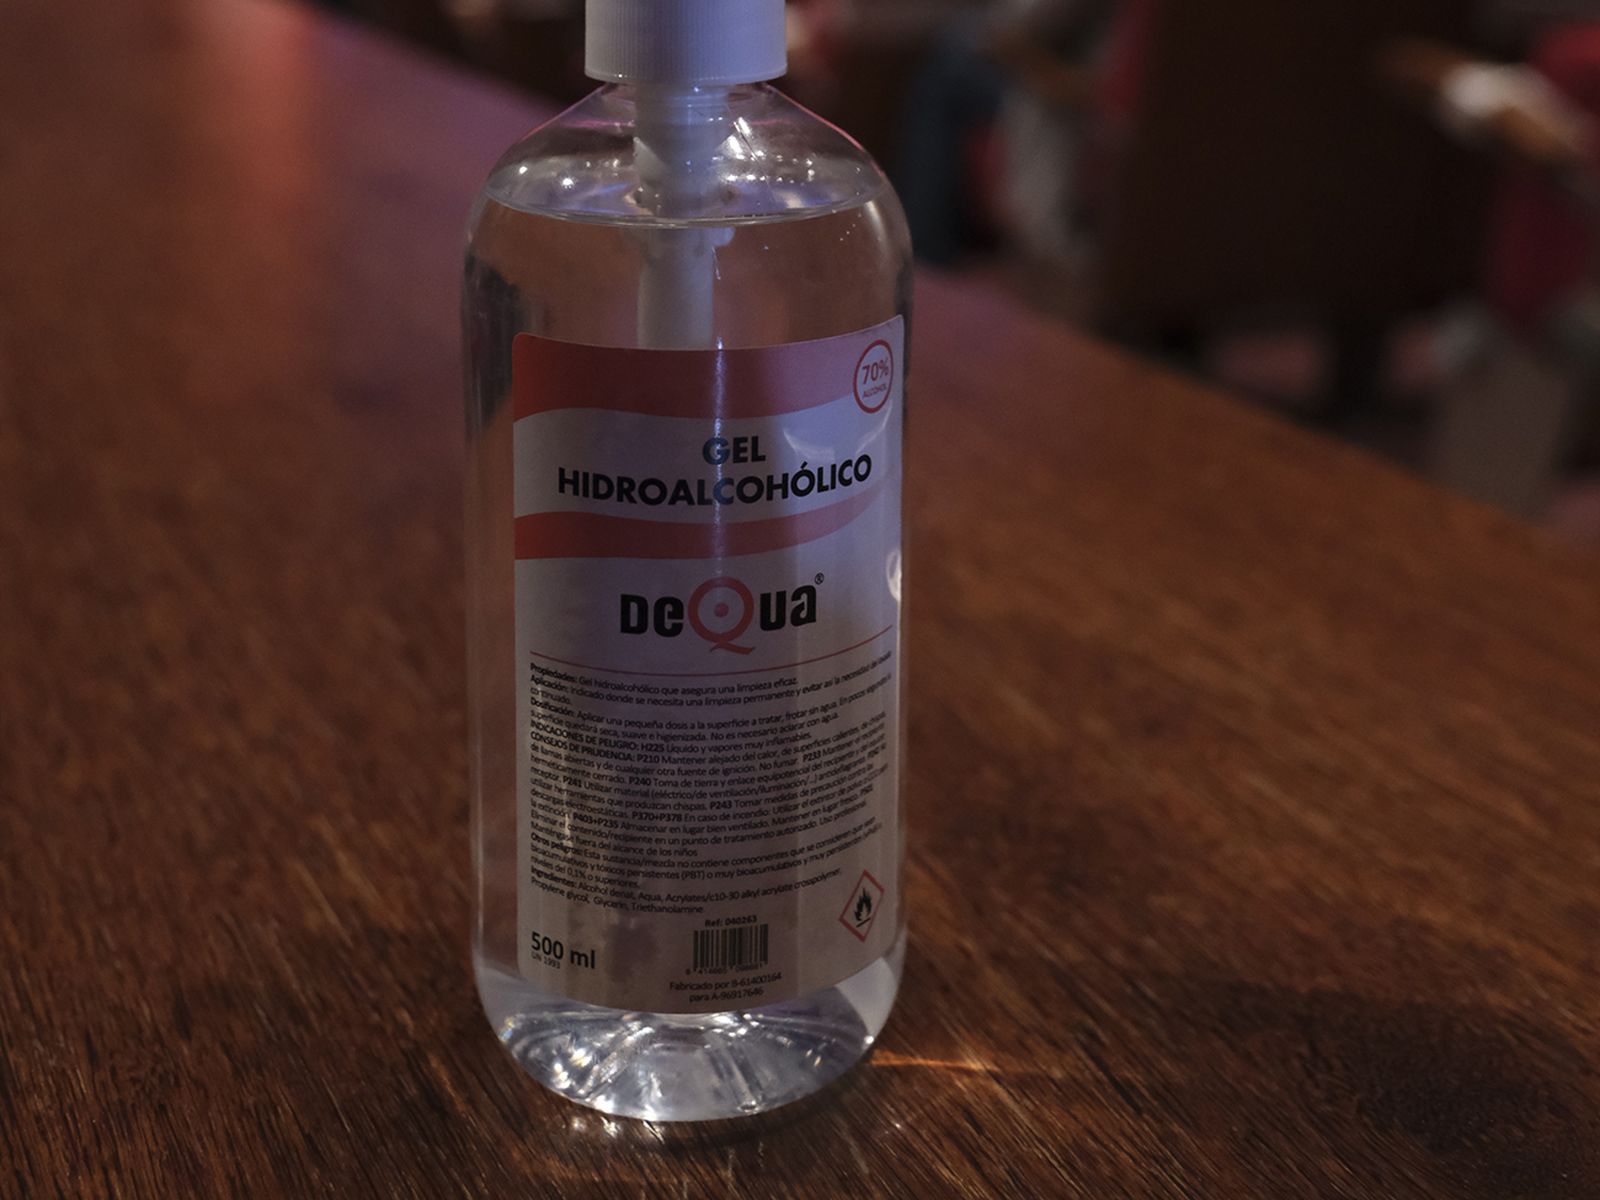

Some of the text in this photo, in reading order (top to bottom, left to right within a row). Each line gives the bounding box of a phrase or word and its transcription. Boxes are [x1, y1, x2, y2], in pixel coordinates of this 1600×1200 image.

[861, 356, 889, 385] 70%
[702, 435, 767, 466] GEL
[557, 454, 873, 506] HIDROALCOHÓLICO
[662, 687, 678, 695] que
[681, 687, 715, 696] asegura
[737, 682, 771, 692] limpieza
[605, 692, 633, 703] donde
[647, 698, 683, 706] necesita
[704, 697, 741, 707] limpieza
[743, 689, 794, 705] permanente
[665, 721, 688, 729] dosis
[711, 732, 723, 740] No
[531, 730, 567, 749] CONSEJOS
[569, 742, 580, 752] DE
[637, 753, 660, 763] P210
[662, 755, 706, 763] Mantener
[708, 753, 740, 764] alejado
[585, 734, 596, 744] DE
[599, 737, 639, 750] PELIGRO:
[642, 742, 664, 751] H225
[667, 744, 699, 754] Líquido
[708, 743, 742, 753] vapores
[744, 740, 763, 749] muy
[603, 761, 614, 770] de
[616, 764, 655, 775] cualquier
[657, 767, 675, 775] otra
[677, 767, 707, 775] fuente
[709, 767, 721, 775] de
[759, 761, 772, 770] No
[803, 749, 821, 762] P233
[563, 775, 581, 787] P241
[629, 776, 651, 786] P240
[654, 778, 678, 787] Toma
[681, 779, 692, 787] de
[727, 776, 755, 785] enlace
[710, 800, 732, 810] P243
[734, 799, 762, 808] Tomar
[632, 811, 682, 822] P370+P378
[682, 837, 709, 847] punto
[660, 848, 672, 856] los
[531, 930, 596, 969] 500 ml
